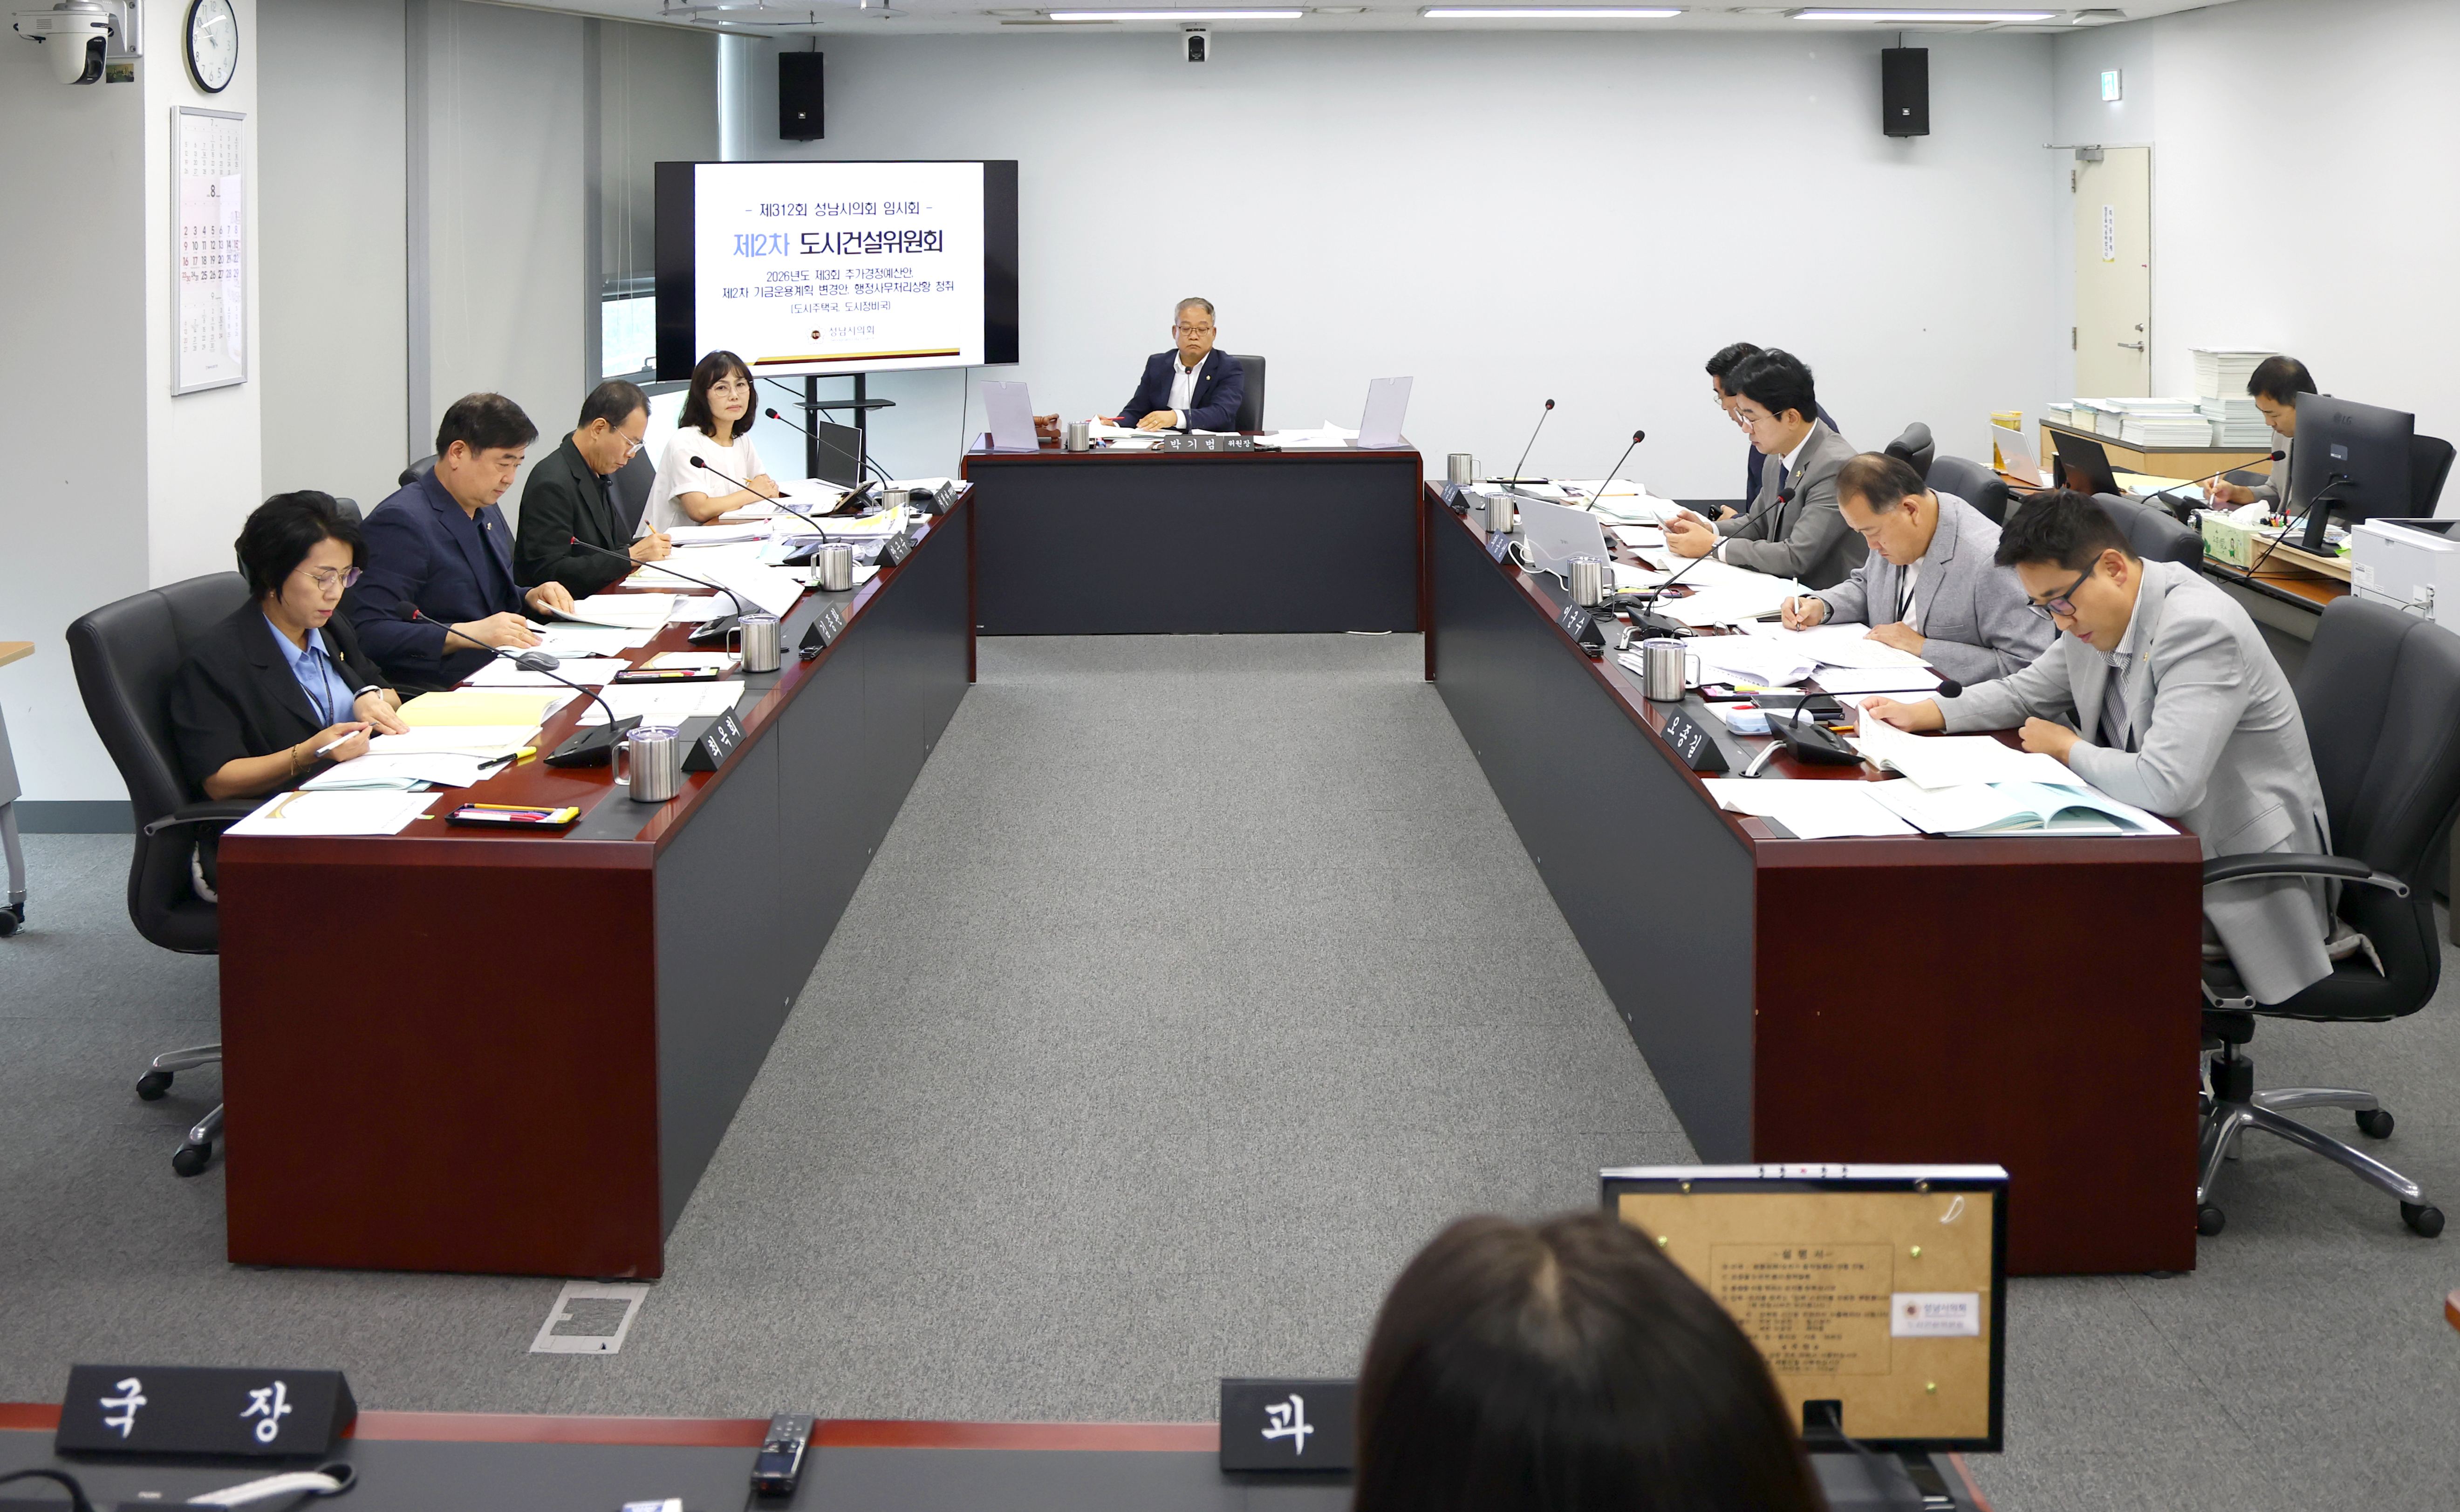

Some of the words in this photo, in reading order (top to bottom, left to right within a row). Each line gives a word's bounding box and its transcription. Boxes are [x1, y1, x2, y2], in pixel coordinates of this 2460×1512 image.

[202, 5, 207, 15] 11
[211, 1, 216, 12] 12
[193, 34, 198, 45] 9
[227, 41, 231, 51] 3
[196, 51, 199, 62] 8
[224, 57, 228, 68] 4
[202, 64, 205, 75] 7
[218, 68, 221, 78] 5
[210, 70, 213, 82] 6
[211, 184, 215, 197] 8
[759, 203, 806, 217] 제312회
[814, 202, 876, 217] 성남시의회
[884, 201, 919, 215] 임시회
[184, 226, 188, 235] 2
[193, 226, 197, 235] 3
[203, 226, 206, 235] 4
[212, 226, 215, 235] 5
[219, 225, 223, 234] 6
[227, 225, 230, 234] 7
[235, 225, 238, 234] 8
[184, 241, 187, 251] 9
[192, 241, 198, 250] 10
[202, 241, 206, 250] 11
[211, 240, 215, 249] 12
[219, 240, 224, 249] 13
[226, 240, 231, 249] 14
[234, 239, 239, 249] 15
[733, 233, 790, 257] 제2차
[800, 230, 943, 255] 도시건설위원회
[183, 257, 189, 266] 16
[193, 256, 198, 266] 17
[201, 256, 207, 265] 18
[210, 255, 215, 265] 19
[218, 255, 224, 264] 20
[233, 254, 239, 263] 22
[201, 271, 207, 280] 25
[210, 270, 216, 279] 26
[218, 270, 224, 279] 27
[226, 269, 232, 278] 28
[233, 268, 239, 278] 29
[767, 270, 810, 282] 2026년도
[815, 269, 840, 280] 제3회
[845, 267, 913, 279] 추가경정예산안,
[723, 287, 749, 299] 제2차
[754, 285, 813, 298] 기금운용계획
[819, 284, 849, 296] 변경안,
[854, 281, 931, 294] 행정사무처리상황
[936, 280, 954, 292] 청취
[845, 300, 890, 312] 도시정비국)
[829, 326, 874, 337] 성남시의회
[1170, 438, 1215, 450] 박기범
[1228, 439, 1251, 448] 위원장
[890, 537, 908, 560] 안극수
[819, 607, 842, 639] 김종환
[1562, 604, 1585, 635] 이군수
[707, 716, 741, 757] 최옥희
[1667, 716, 1702, 758] 오종길
[1260, 1393, 1315, 1456] 과
